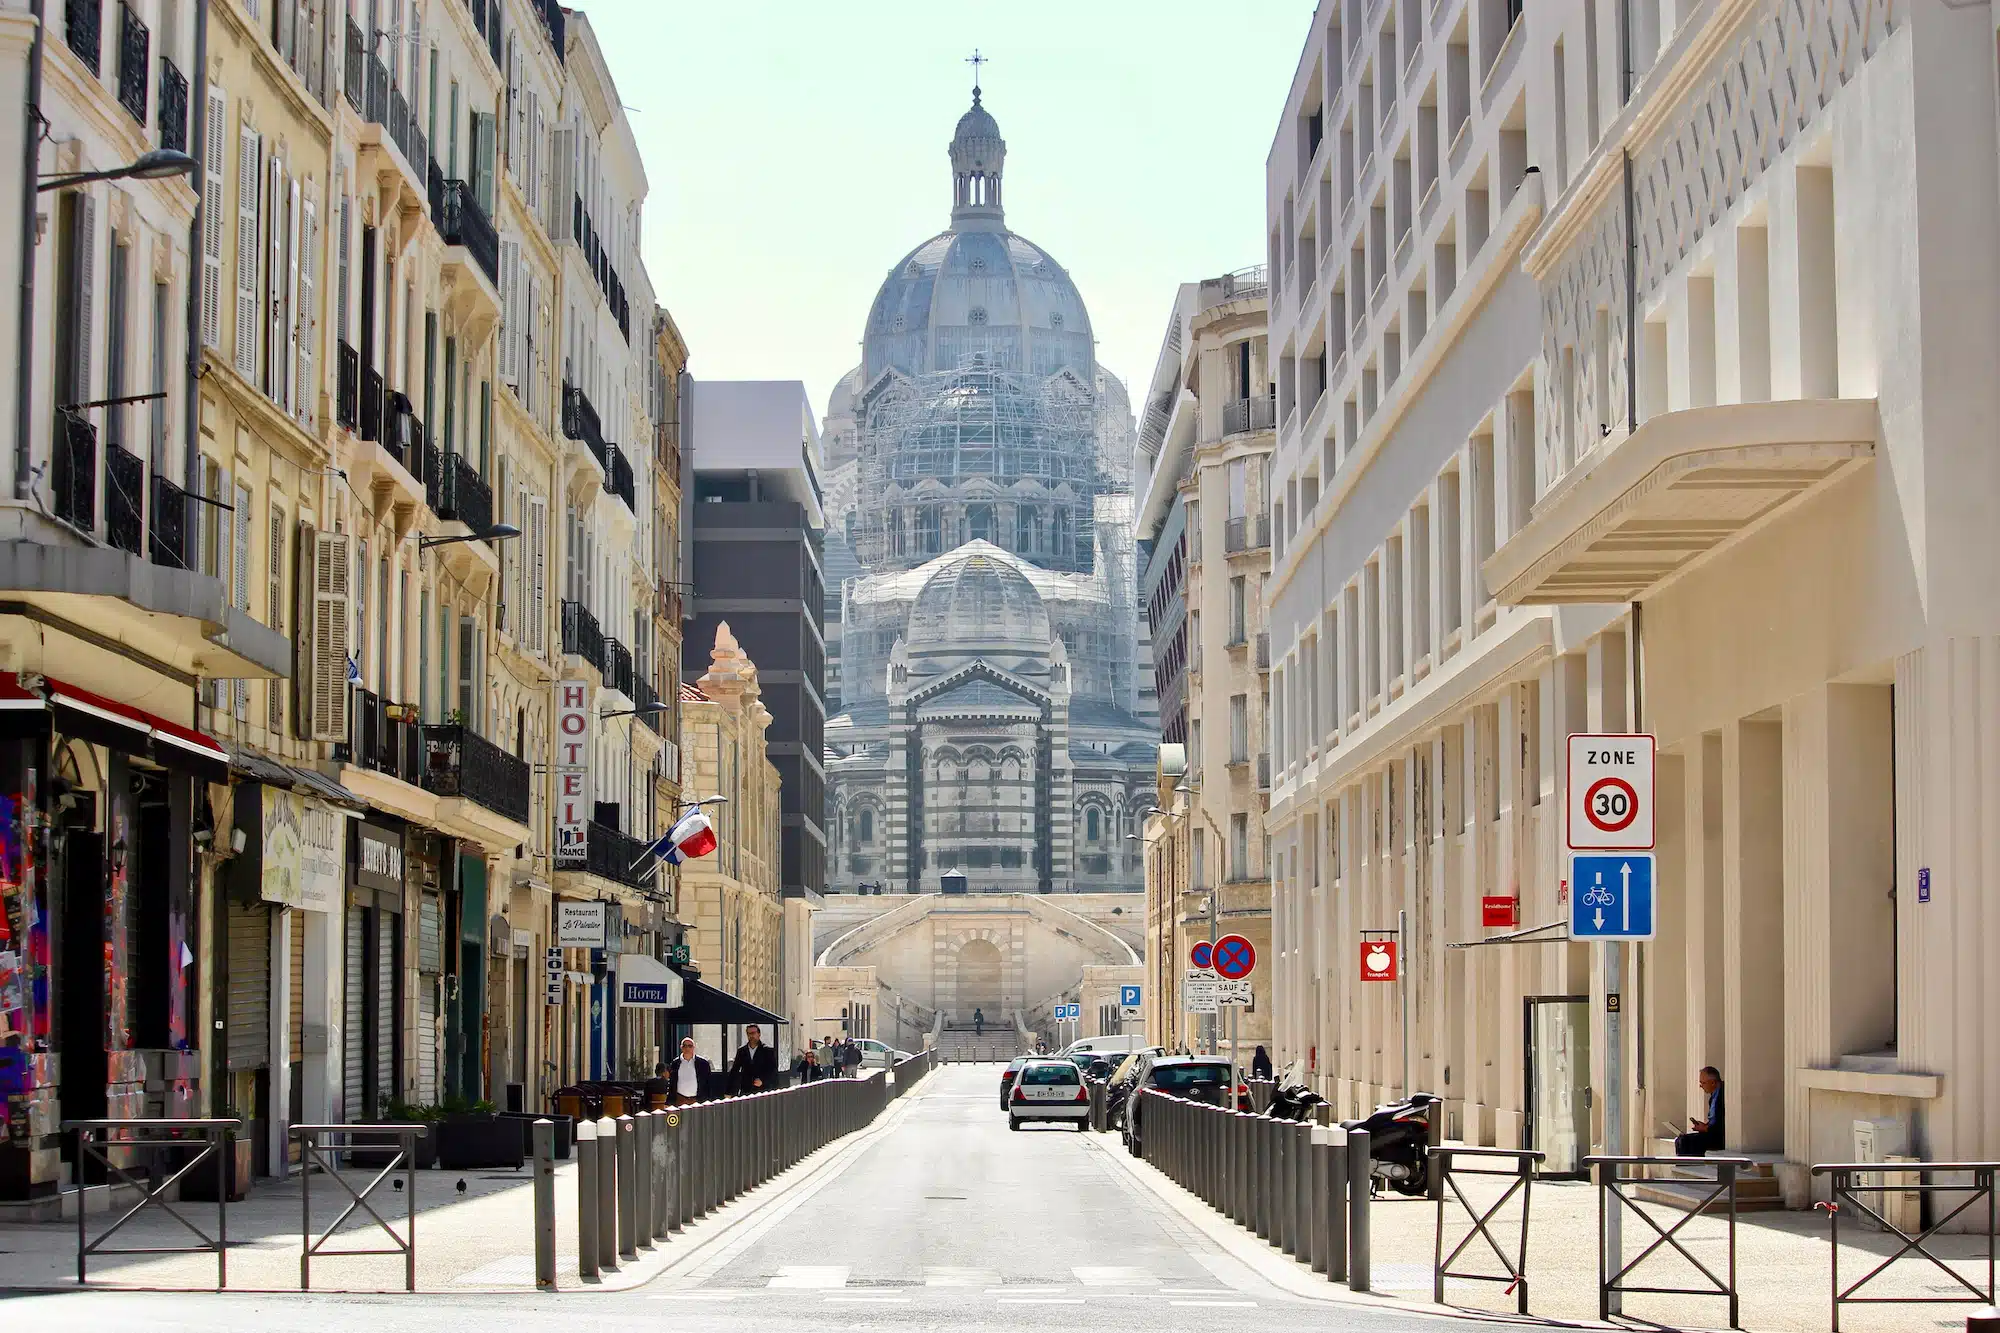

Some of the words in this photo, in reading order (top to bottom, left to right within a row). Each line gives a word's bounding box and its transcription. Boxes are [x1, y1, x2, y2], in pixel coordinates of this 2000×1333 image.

[561, 686, 586, 825] HOTEL
[1587, 751, 1635, 765] ZONE
[1595, 793, 1627, 816] 30
[559, 848, 585, 857] FRANCE
[564, 908, 598, 917] Restaurant
[548, 948, 562, 1004] HOTEL
[1125, 989, 1136, 1003] P
[1057, 1008, 1064, 1017] P
[1069, 1006, 1077, 1015] P
